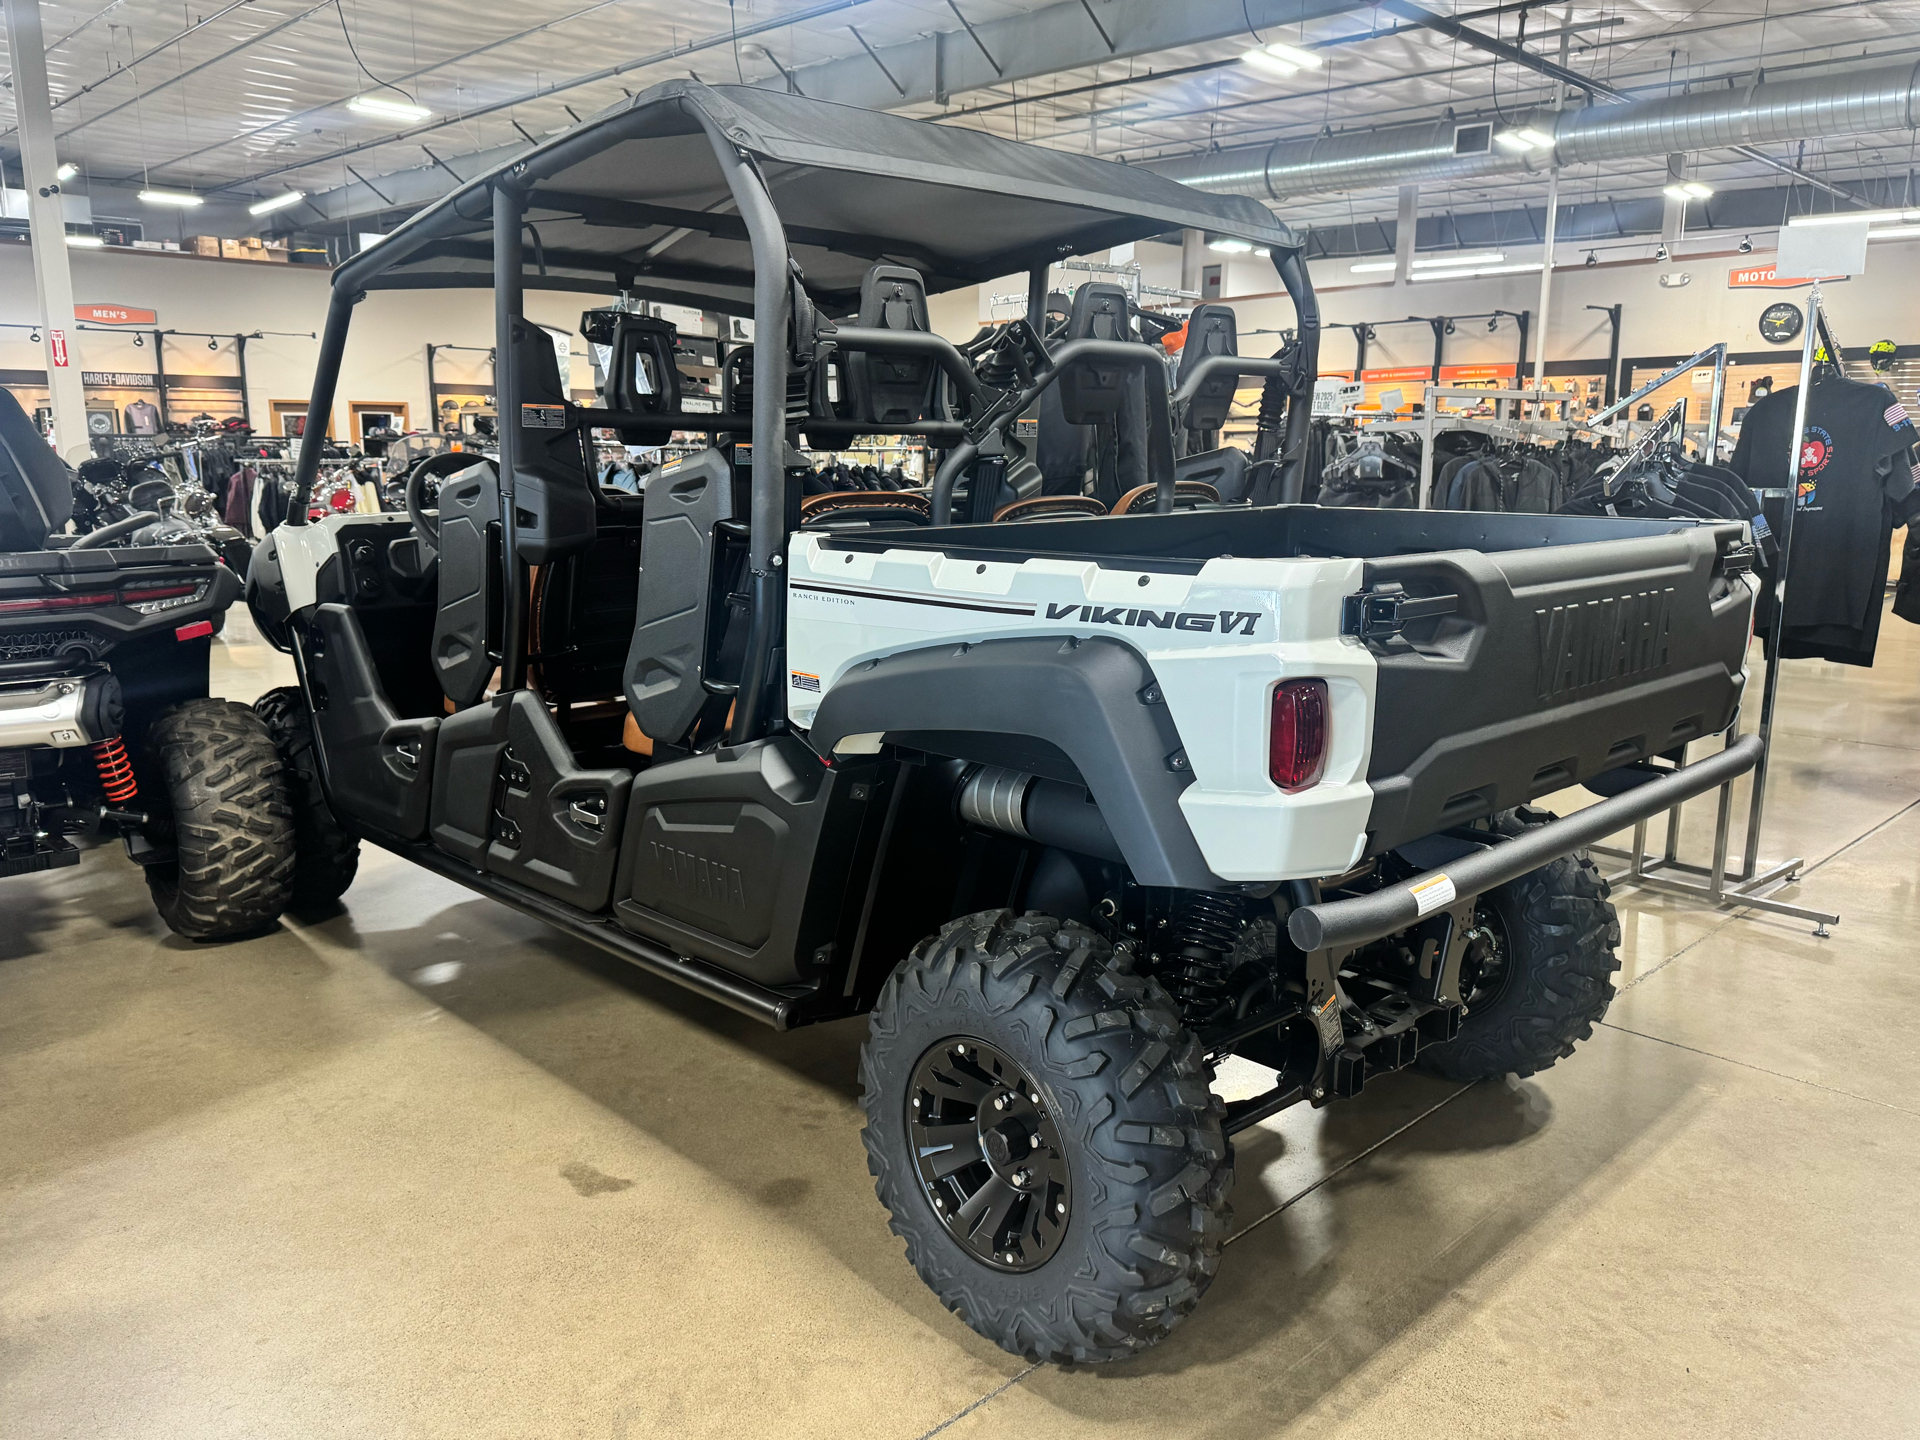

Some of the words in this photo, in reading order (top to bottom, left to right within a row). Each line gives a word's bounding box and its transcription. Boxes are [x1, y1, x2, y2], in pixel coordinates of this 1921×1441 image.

[1738, 270, 1776, 283] MOTO
[92, 309, 128, 320] MEN'S
[83, 372, 154, 386] HARLEY-DAVIDSON
[1810, 425, 1833, 446] STATE
[1808, 446, 1834, 477] SPORTS
[792, 592, 819, 601] RANCH
[821, 596, 856, 606] EDITION
[1045, 602, 1217, 633] VIKING
[1217, 610, 1262, 636] VI
[1535, 587, 1675, 698] YAMAHA
[649, 840, 747, 911] YAMAHA
